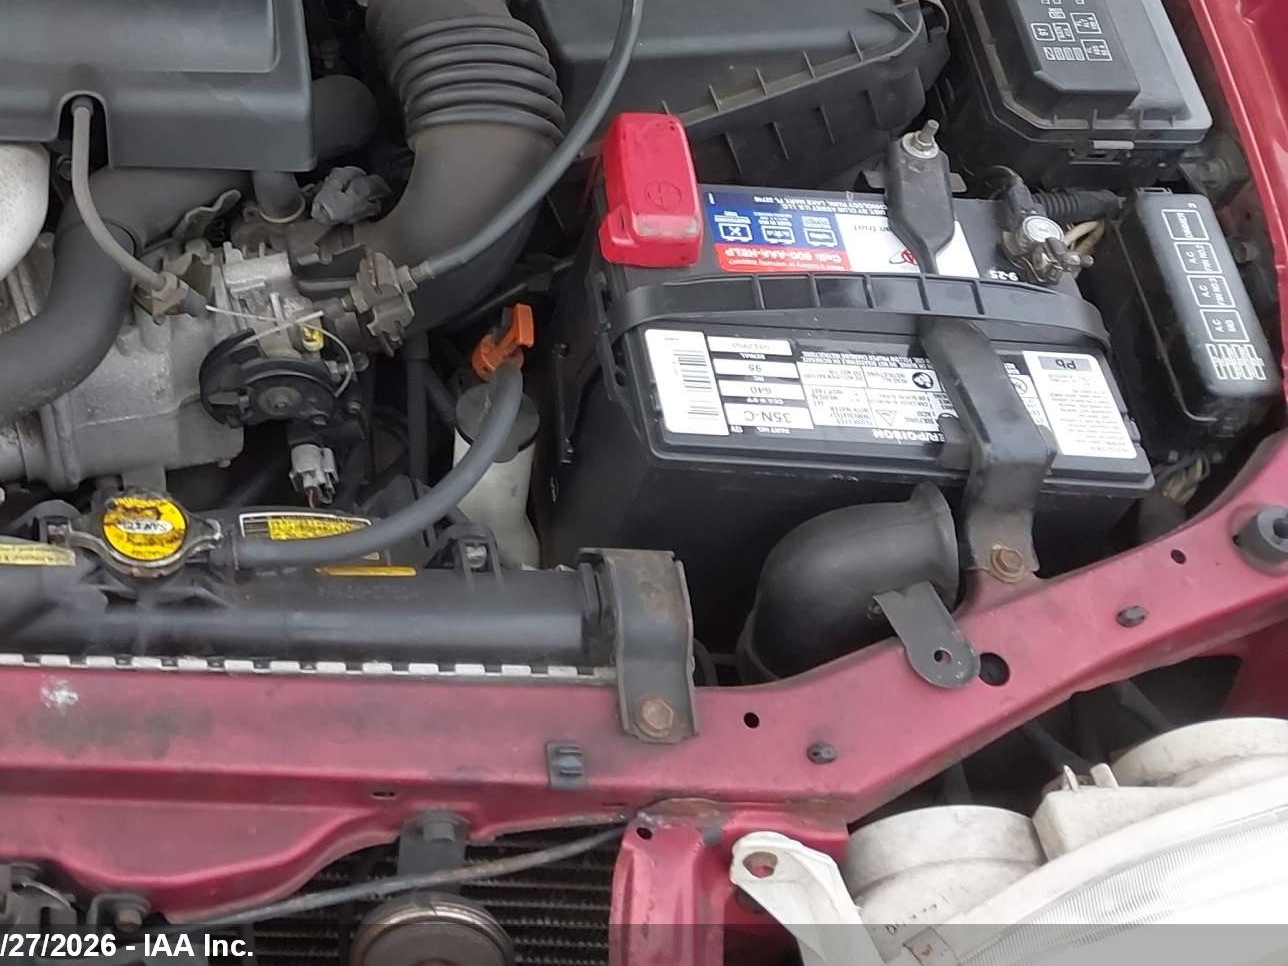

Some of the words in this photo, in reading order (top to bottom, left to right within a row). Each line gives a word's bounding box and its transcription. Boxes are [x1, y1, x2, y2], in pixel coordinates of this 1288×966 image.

[748, 364, 762, 372] 95
[1055, 358, 1077, 370] Pb
[750, 387, 772, 395] 640
[743, 410, 792, 423] 35N-C
